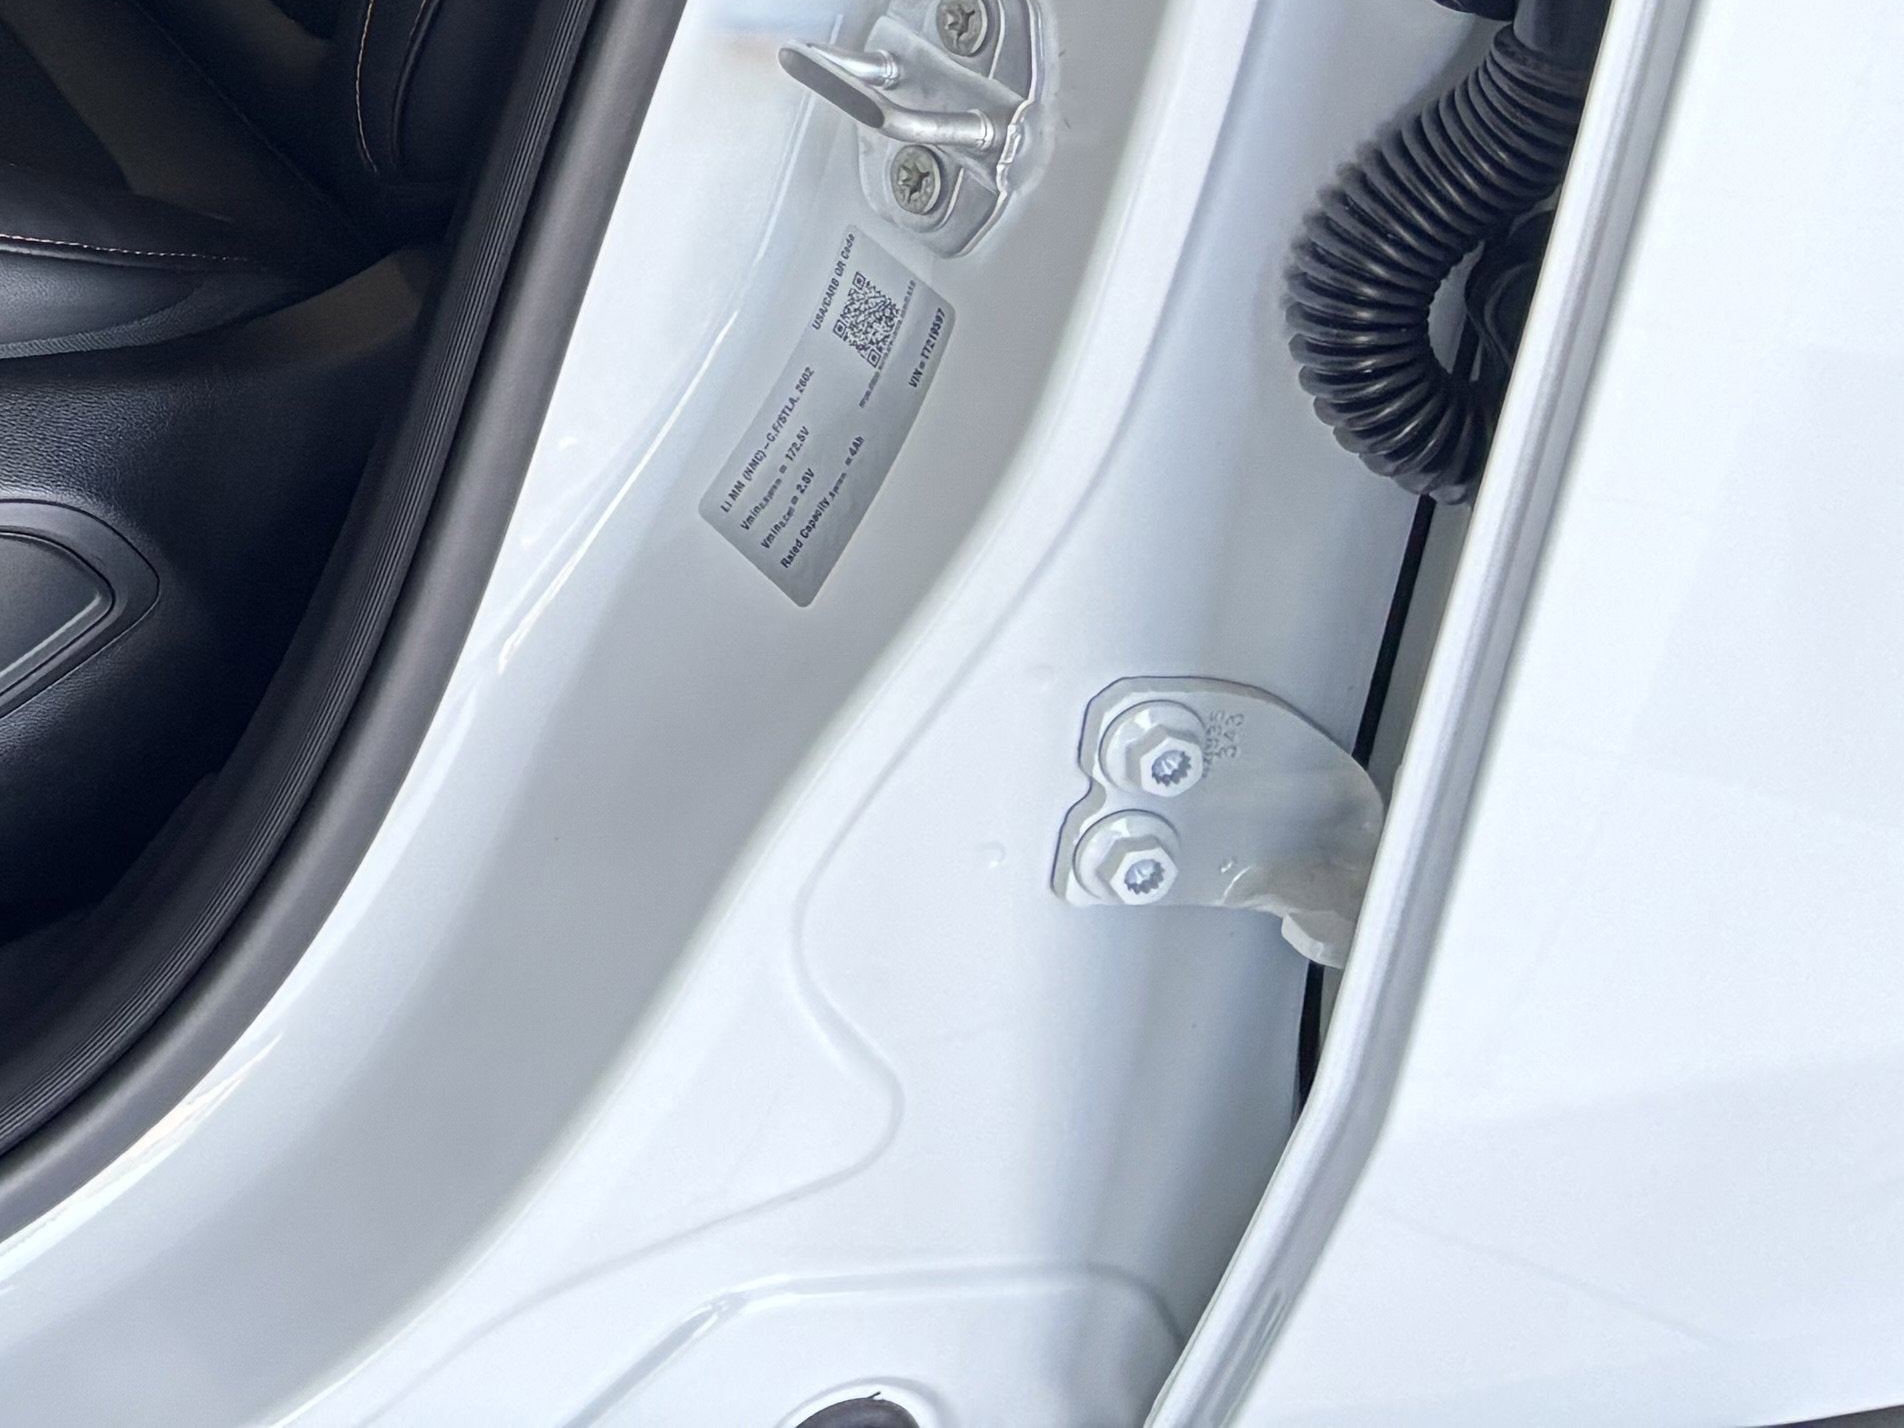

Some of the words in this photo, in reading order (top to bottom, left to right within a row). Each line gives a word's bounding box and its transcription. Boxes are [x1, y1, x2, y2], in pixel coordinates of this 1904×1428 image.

[908, 368, 922, 387] VIN
[779, 538, 803, 568] Rated
[798, 495, 831, 539] Capacity
